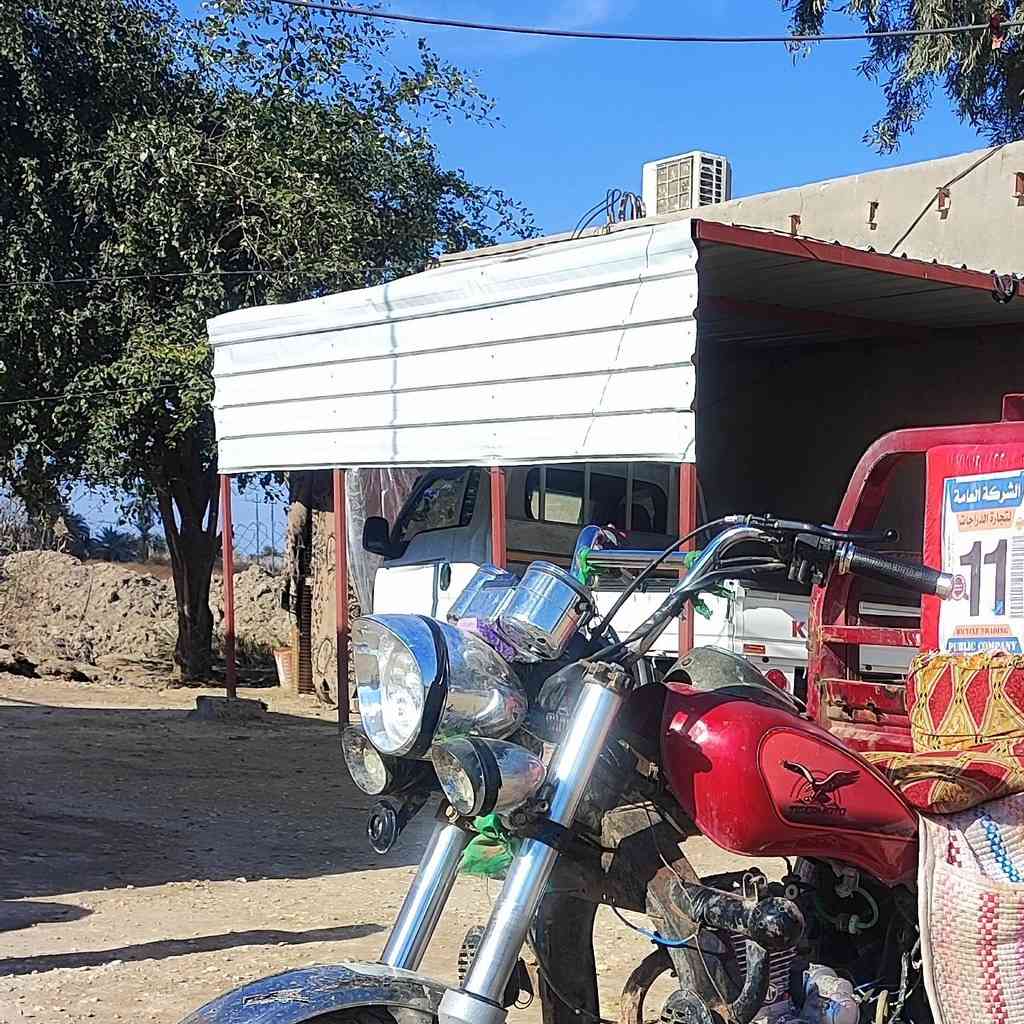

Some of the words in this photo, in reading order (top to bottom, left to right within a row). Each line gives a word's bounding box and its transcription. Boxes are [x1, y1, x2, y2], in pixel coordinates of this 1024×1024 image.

[953, 487, 981, 504] العامة
[982, 480, 1021, 503] الشركة
[960, 539, 1008, 617] 11
[949, 641, 976, 651] PUBLIC
[978, 639, 1018, 652] COMPANY
